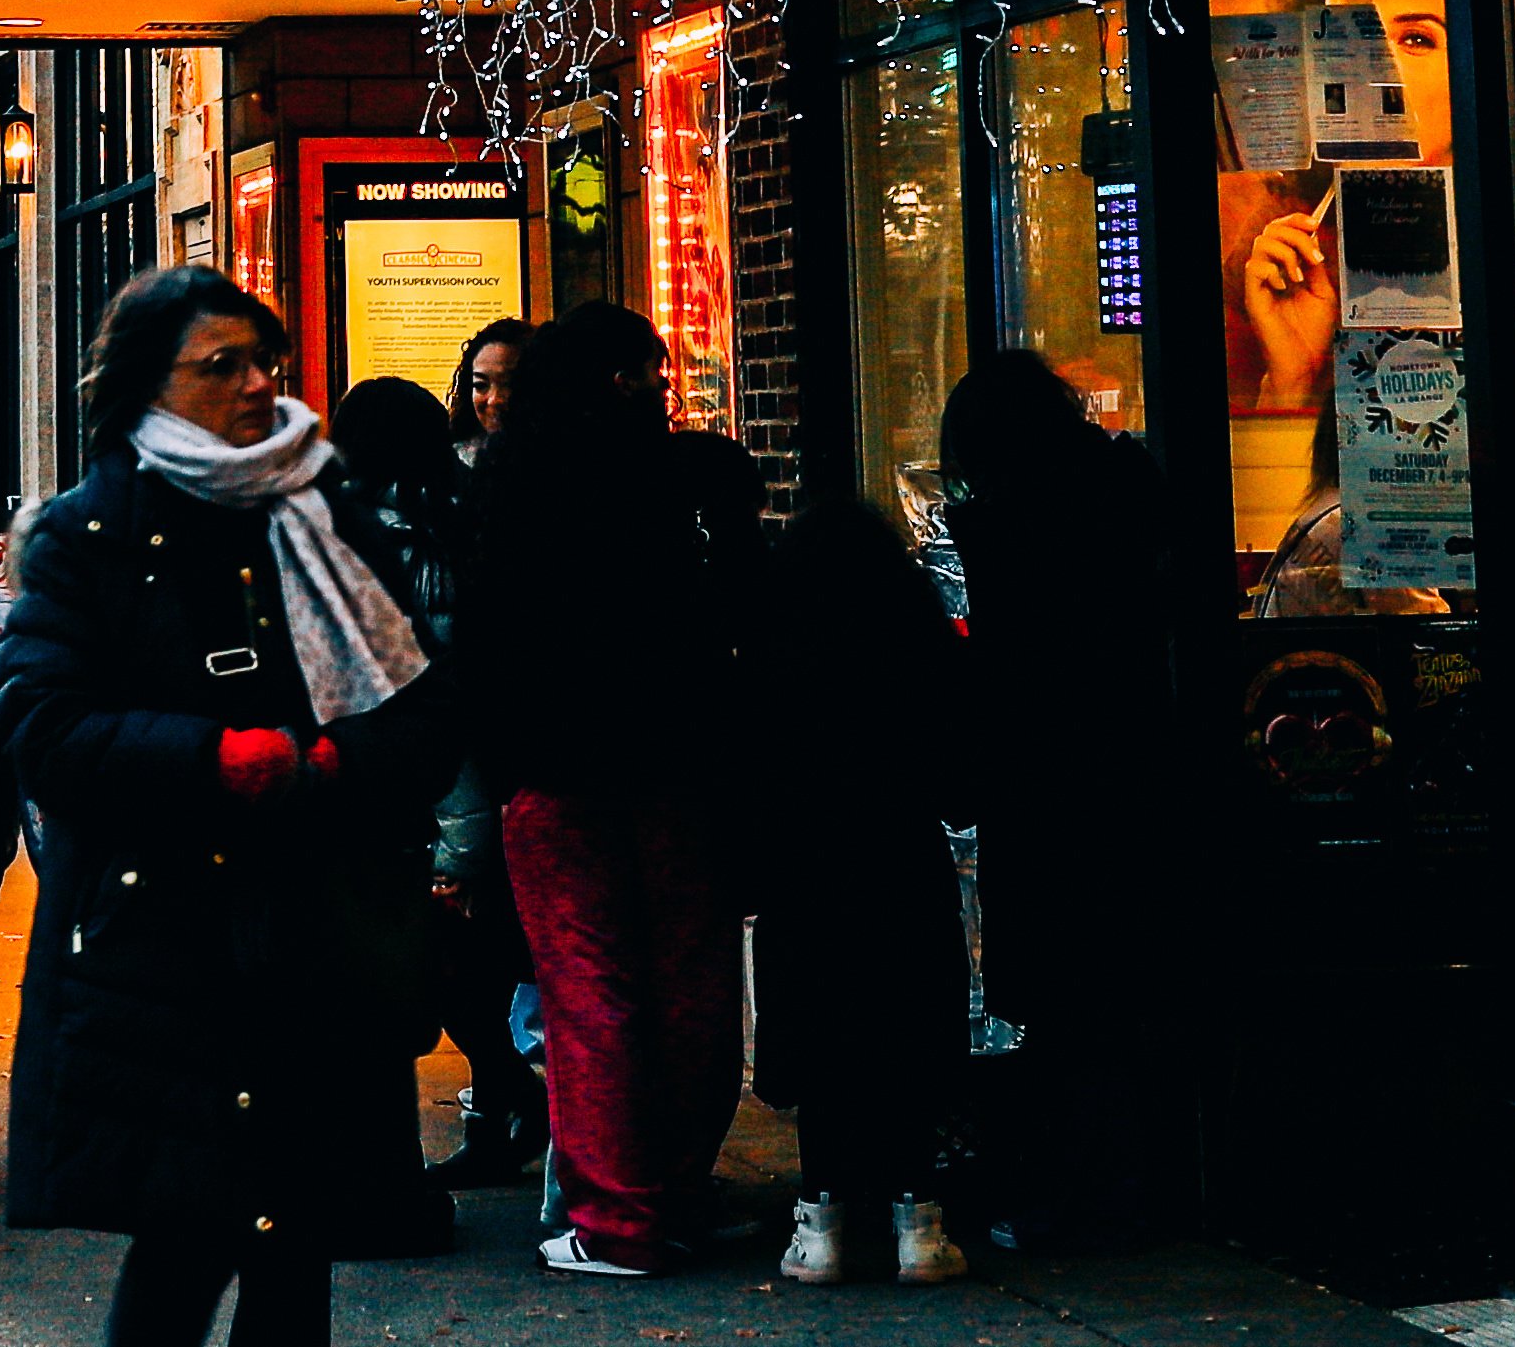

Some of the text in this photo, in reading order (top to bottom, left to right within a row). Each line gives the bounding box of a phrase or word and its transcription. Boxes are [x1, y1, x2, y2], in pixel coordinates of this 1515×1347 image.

[358, 182, 506, 200] NOW SHOWING
[367, 277, 500, 287] YOUTH SUPERVISION POLICY
[1381, 370, 1454, 394] HOLIDAYS
[1394, 453, 1449, 468] SATURDAY
[1369, 468, 1426, 483] DECEMBER
